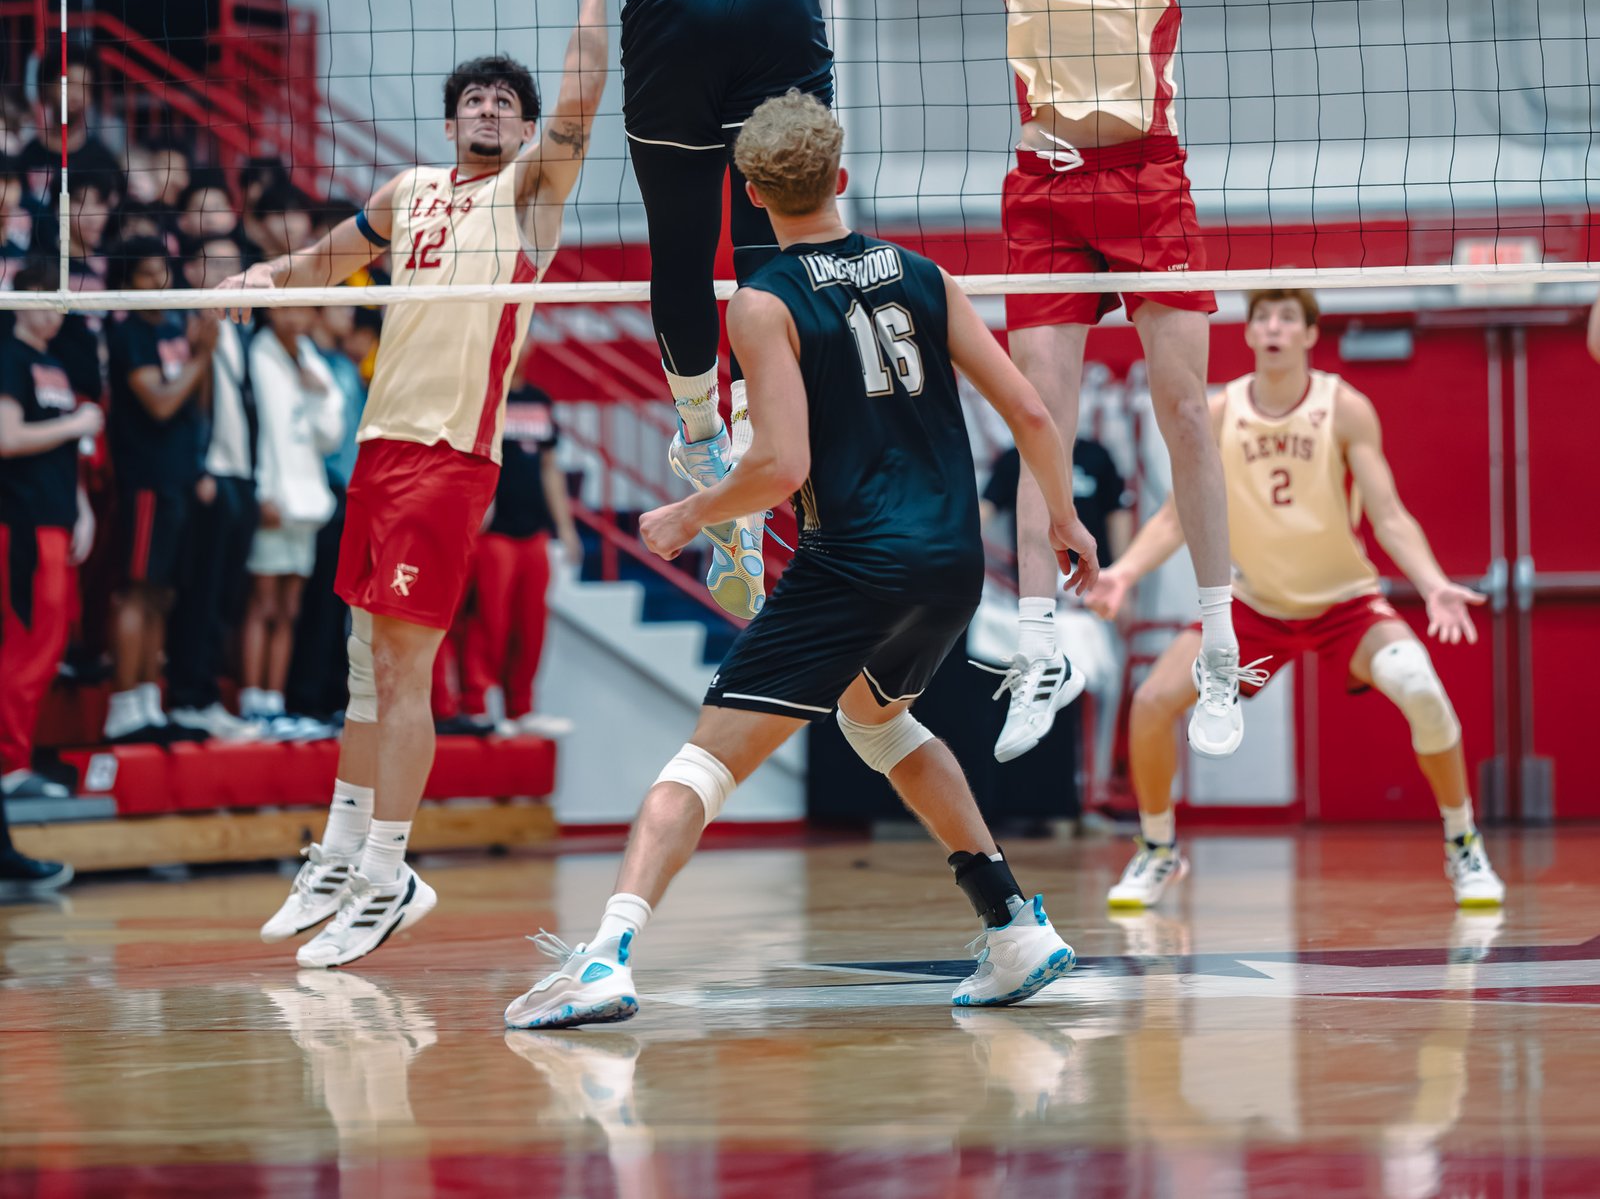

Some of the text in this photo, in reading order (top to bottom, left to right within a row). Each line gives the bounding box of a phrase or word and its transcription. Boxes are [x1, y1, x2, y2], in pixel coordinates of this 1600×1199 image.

[405, 226, 447, 270] 12
[845, 299, 925, 397] 16
[1242, 433, 1315, 465] LEWIS
[1269, 468, 1293, 506] 2
